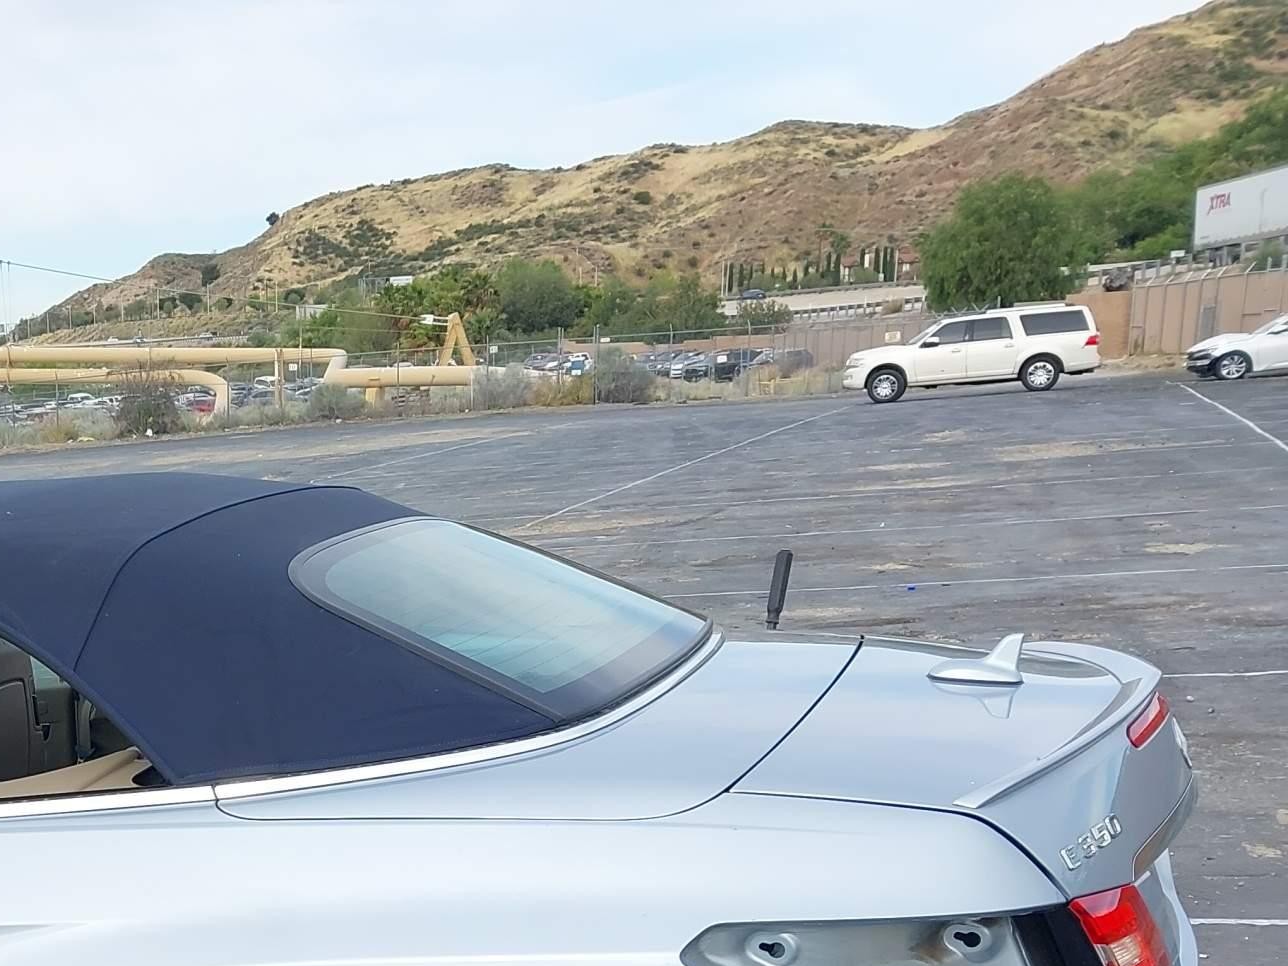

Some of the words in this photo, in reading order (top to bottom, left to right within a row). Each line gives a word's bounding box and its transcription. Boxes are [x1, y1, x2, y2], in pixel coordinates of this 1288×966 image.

[1207, 192, 1231, 215] XTRA
[1059, 845, 1082, 871] E
[1077, 813, 1123, 859] 350
